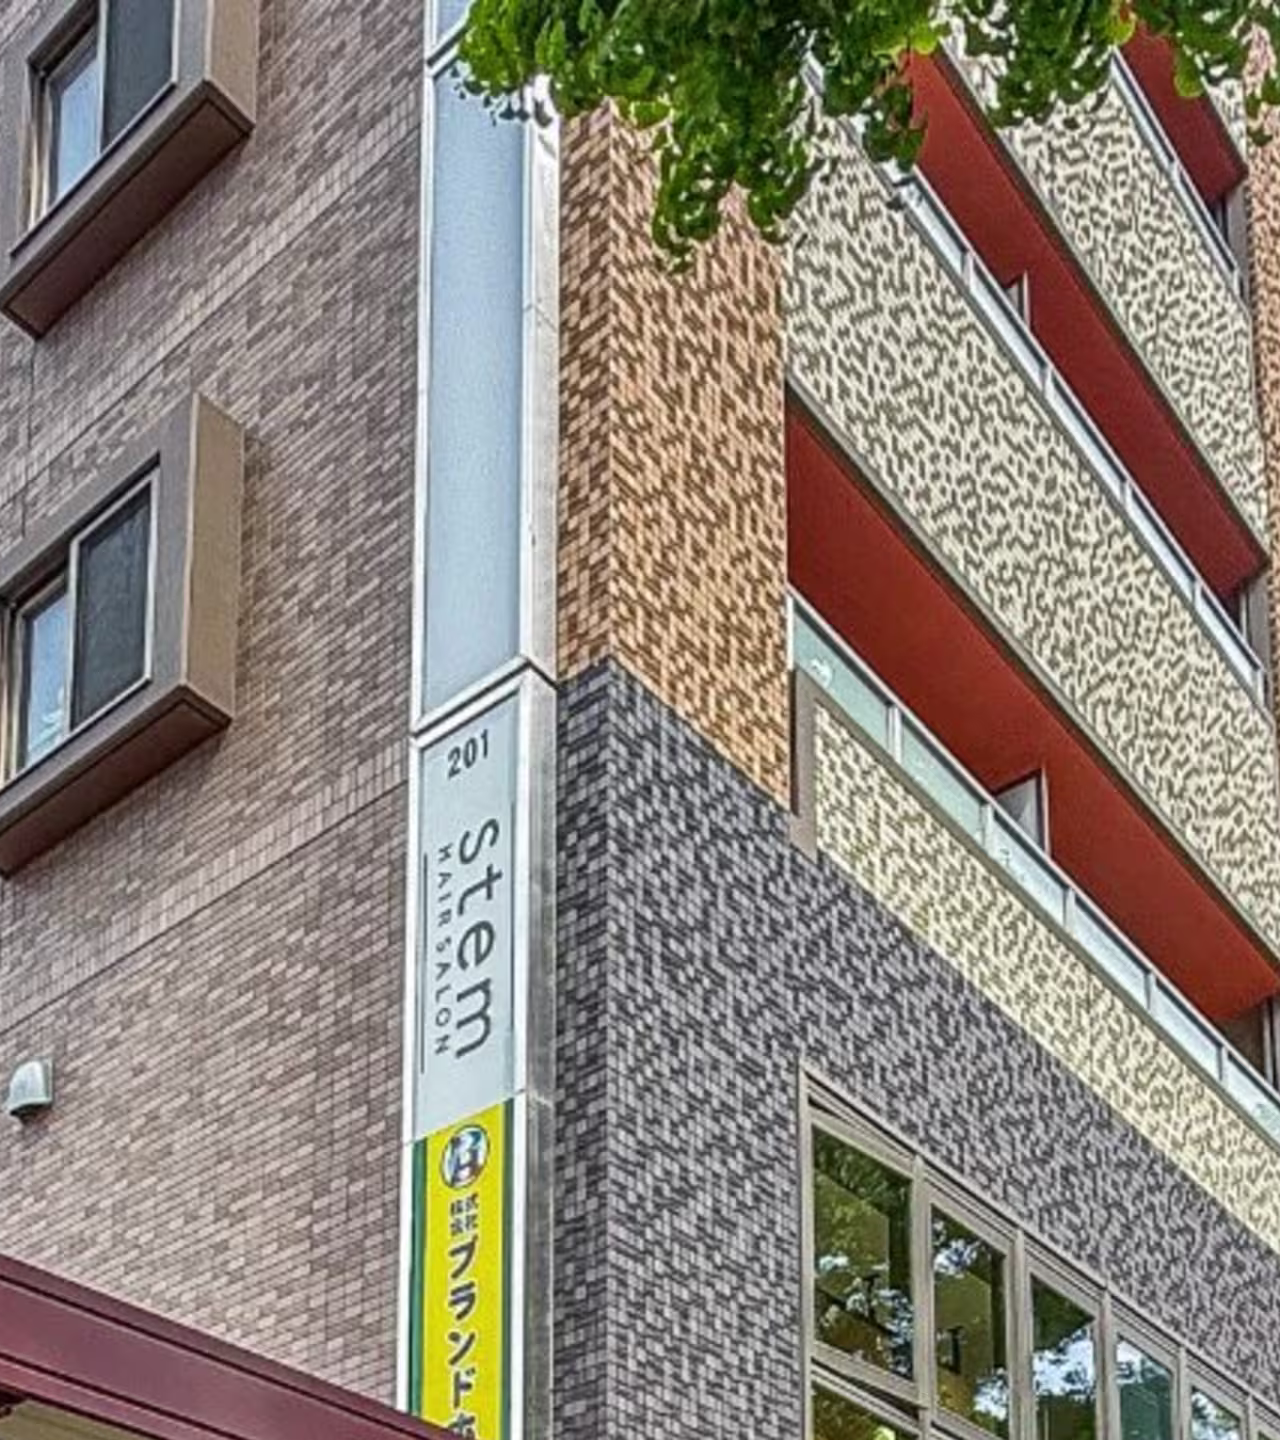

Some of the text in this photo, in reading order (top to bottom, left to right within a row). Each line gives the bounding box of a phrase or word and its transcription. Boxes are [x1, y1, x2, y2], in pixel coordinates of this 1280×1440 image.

[447, 728, 488, 780] 201
[434, 843, 454, 1055] HAIR SALON
[456, 818, 503, 1059] Stem
